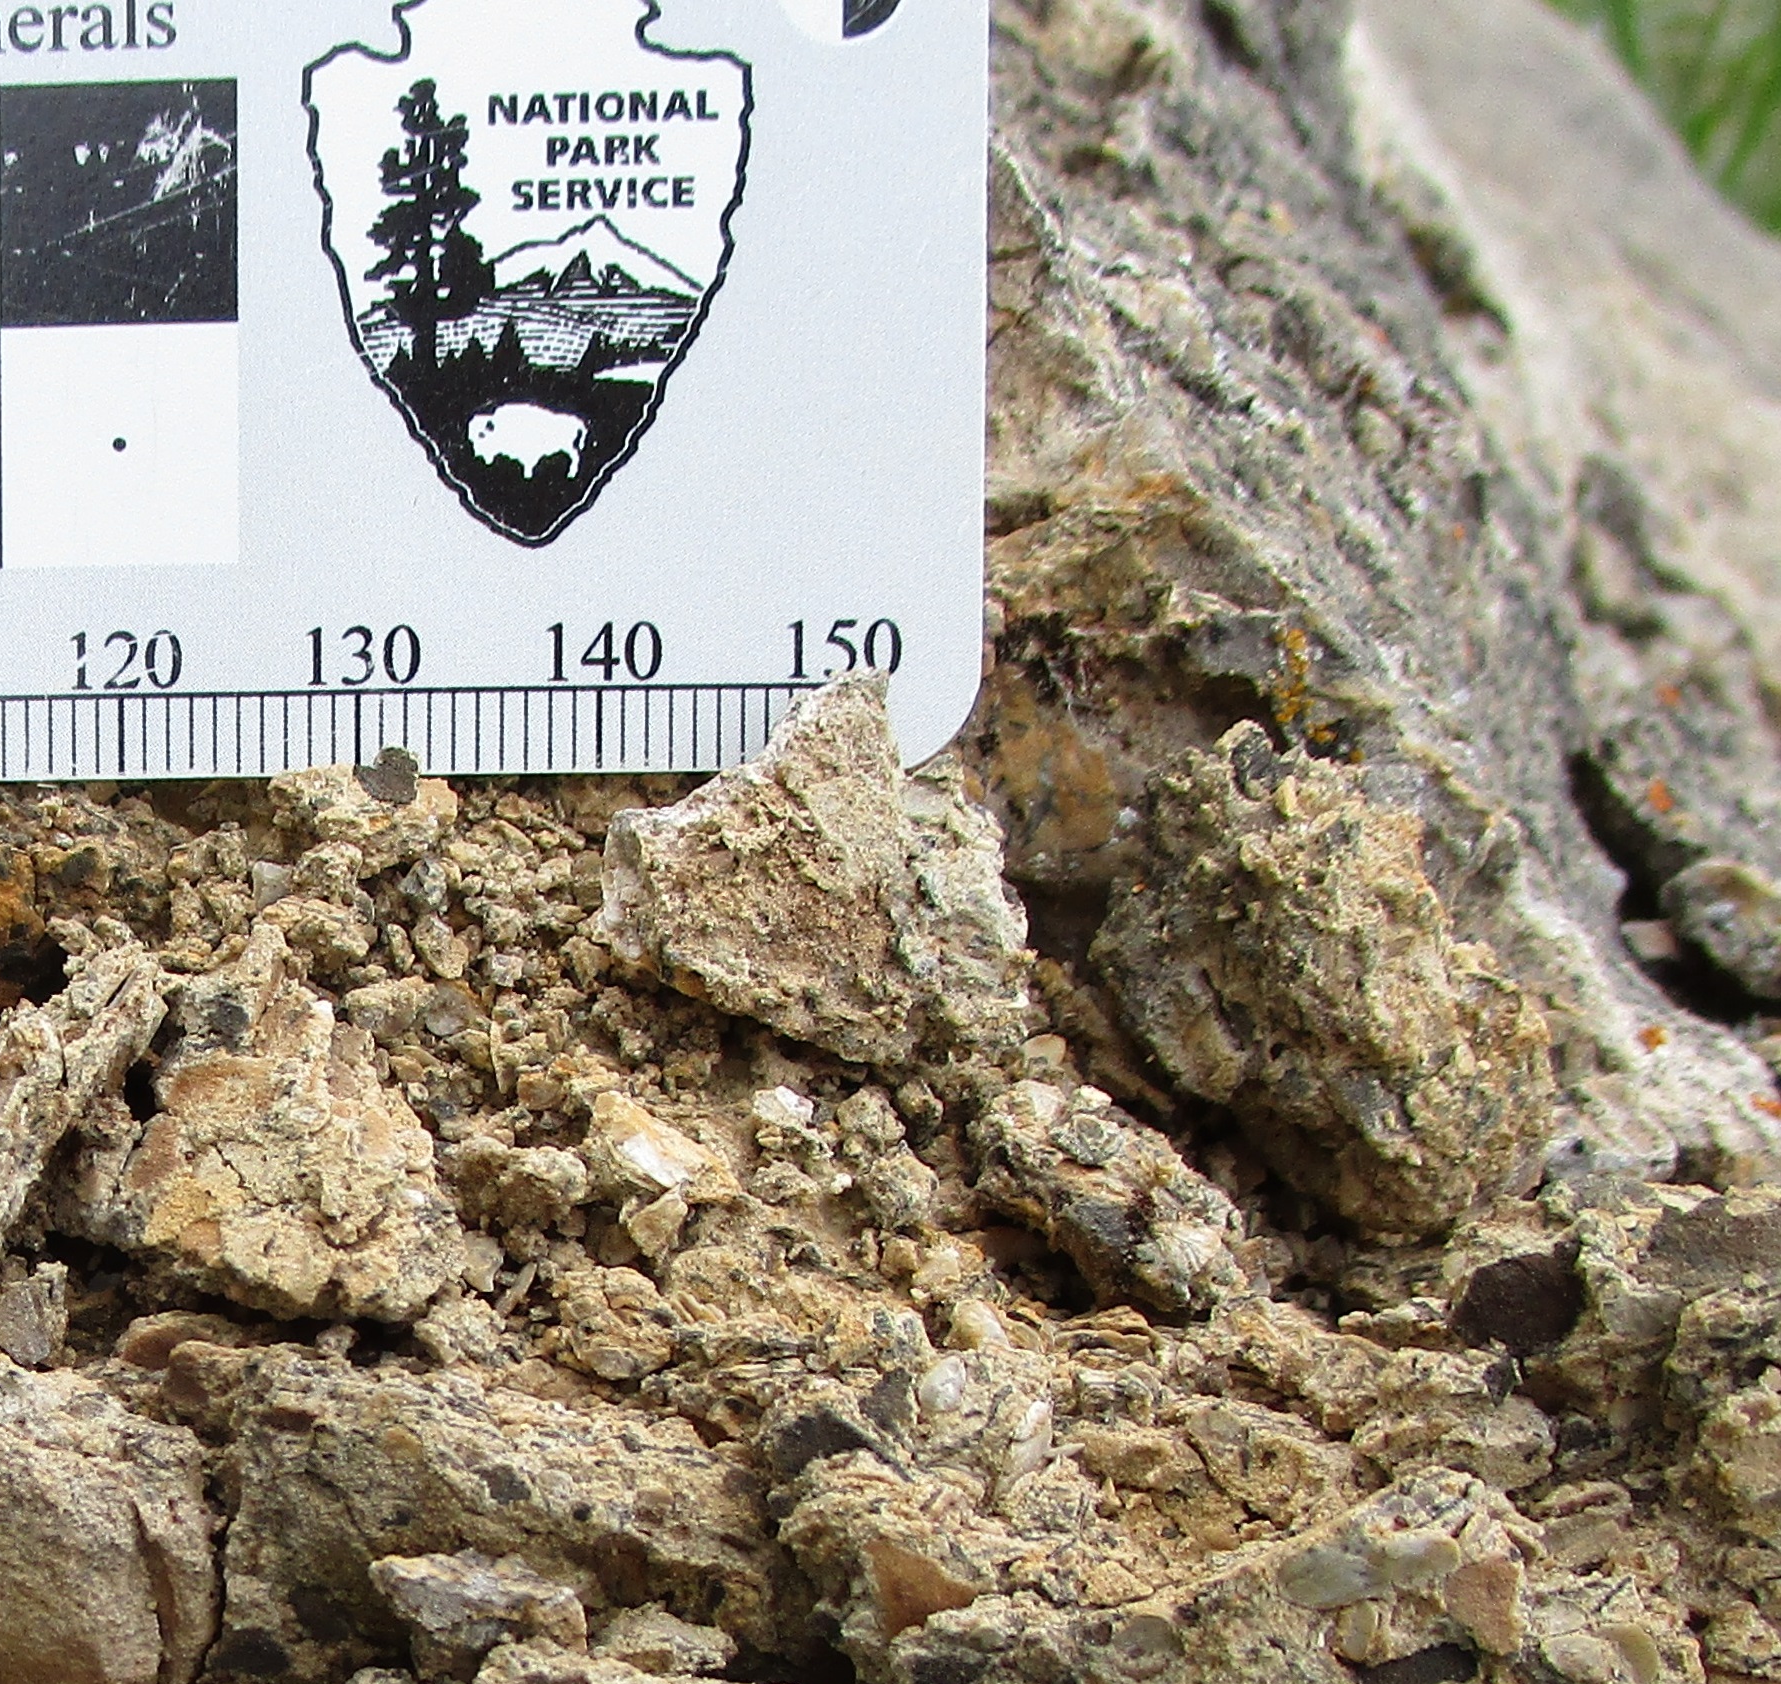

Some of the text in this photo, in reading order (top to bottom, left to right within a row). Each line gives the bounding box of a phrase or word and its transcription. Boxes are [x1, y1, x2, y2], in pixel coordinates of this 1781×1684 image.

[488, 90, 719, 126] NATIONAL
[547, 135, 659, 167] PARK
[512, 177, 694, 211] SERVICE
[71, 630, 182, 690] 120
[307, 624, 421, 686] 130
[546, 621, 663, 682] 140
[788, 618, 902, 679] 150
